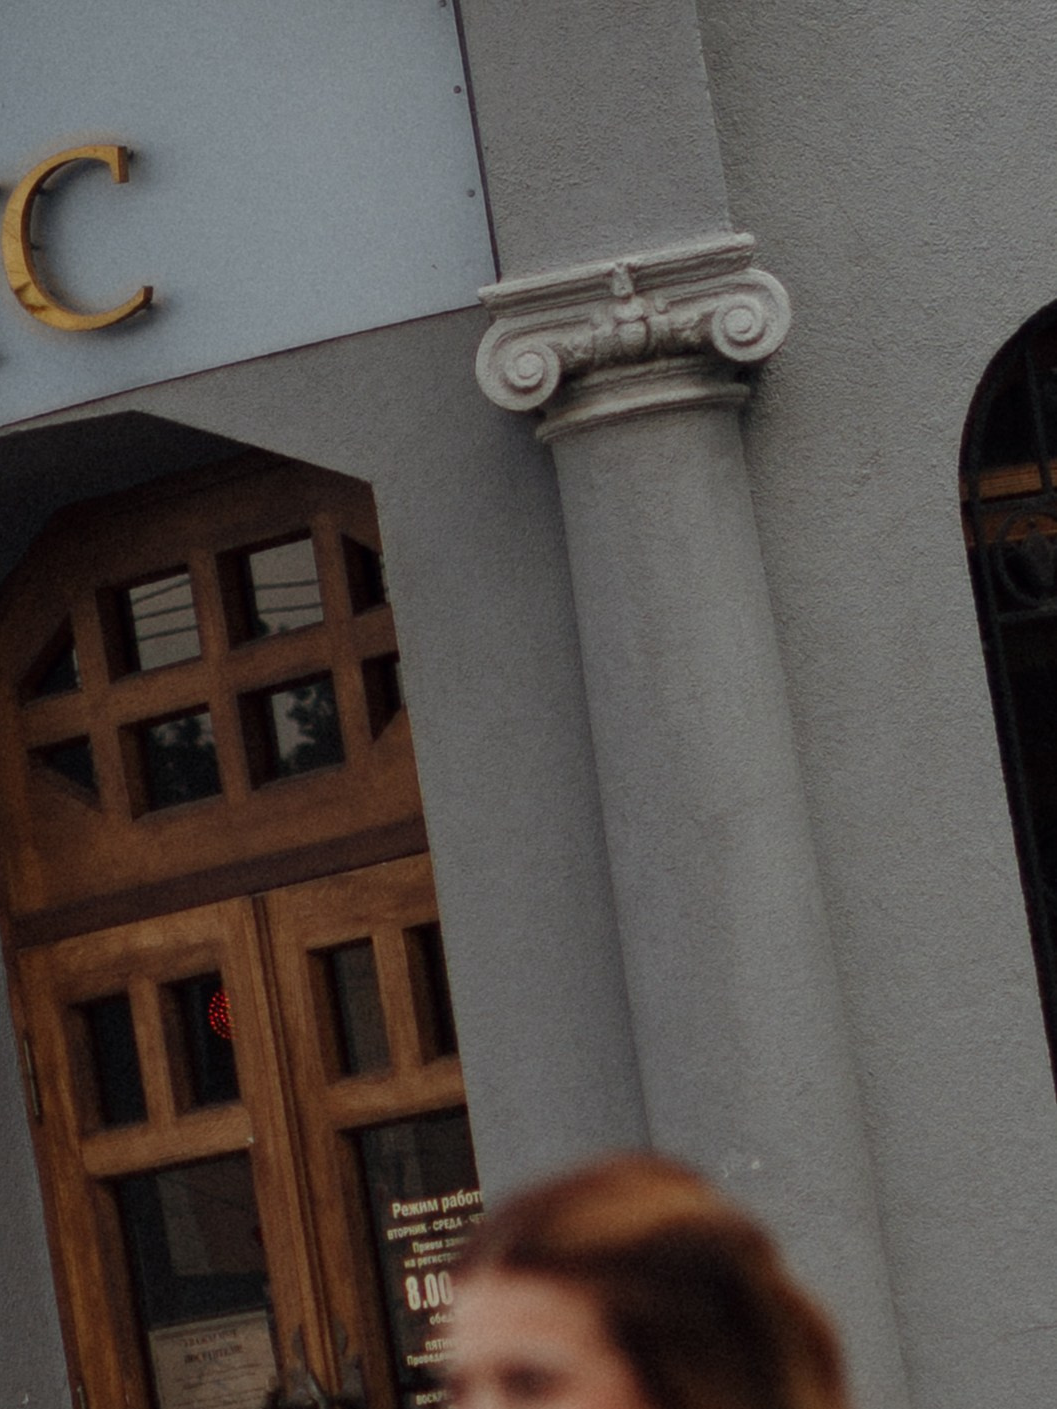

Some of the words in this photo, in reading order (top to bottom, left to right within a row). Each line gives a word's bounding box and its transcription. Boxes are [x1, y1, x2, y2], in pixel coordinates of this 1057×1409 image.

[392, 1199, 439, 1218] Режим
[387, 1223, 427, 1240] ВТОРНИК
[432, 1216, 463, 1231] СРЕДА
[405, 1271, 454, 1311] 8.00
